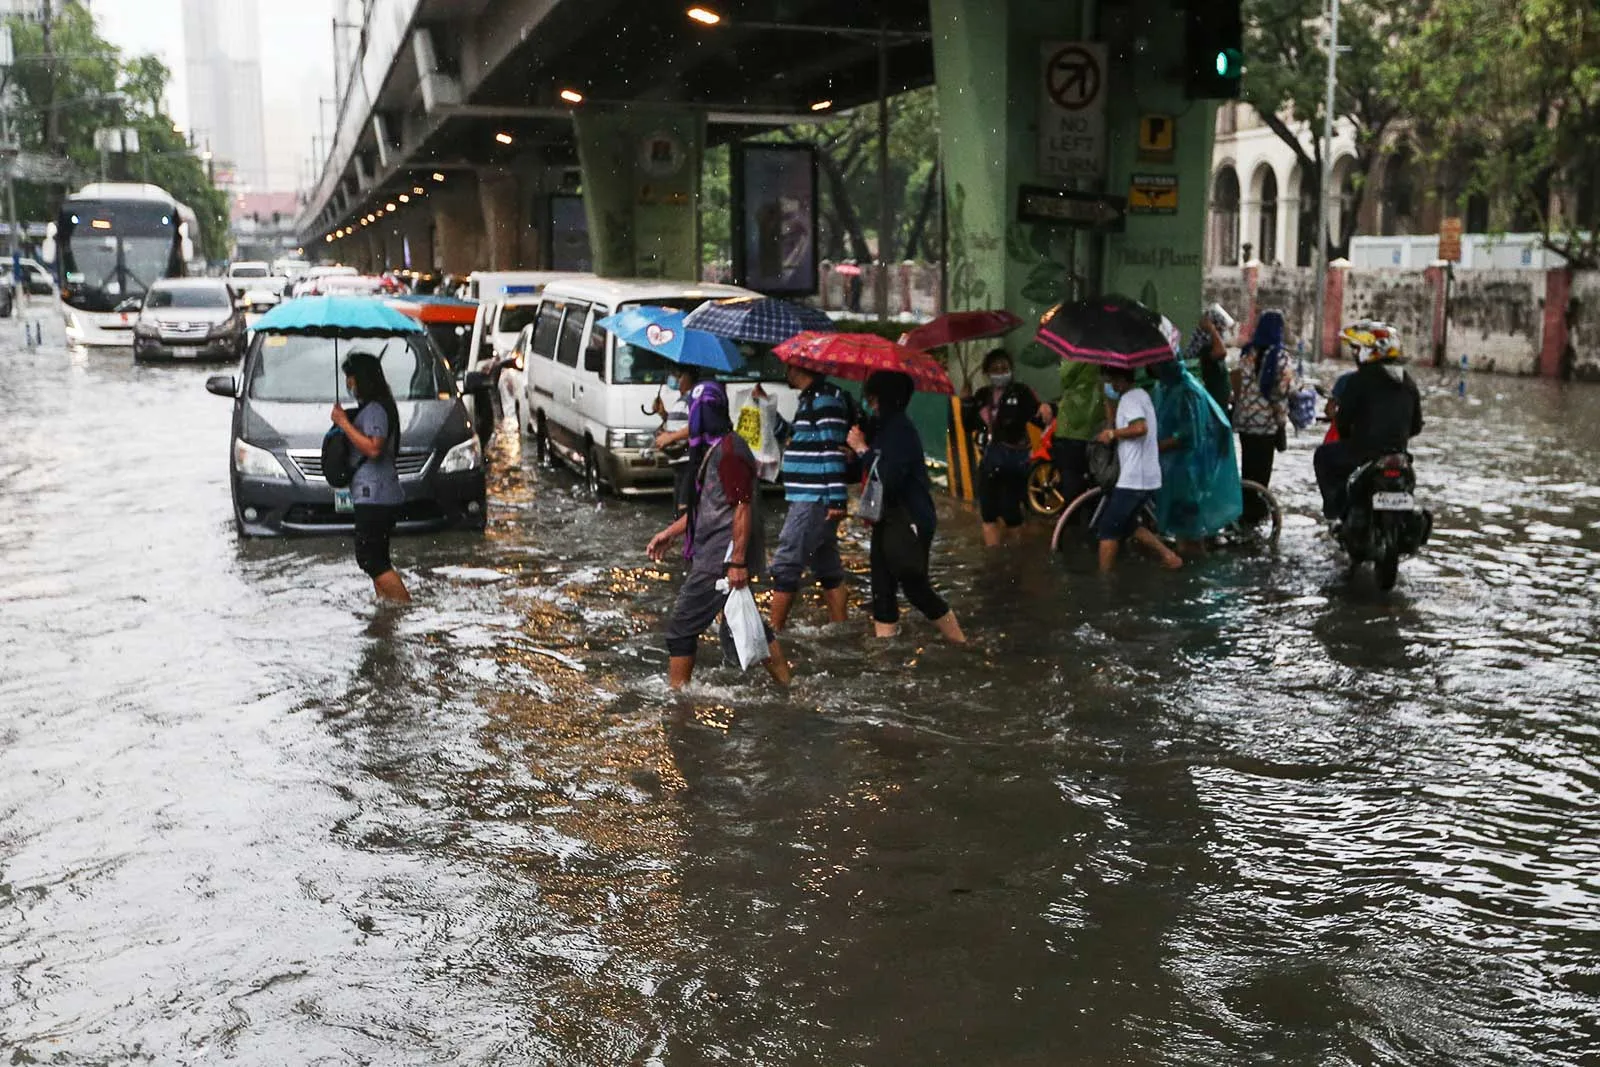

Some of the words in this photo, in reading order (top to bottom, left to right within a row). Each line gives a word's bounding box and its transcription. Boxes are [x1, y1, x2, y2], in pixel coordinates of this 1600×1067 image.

[1061, 116, 1088, 132] NO
[1050, 136, 1093, 152] LEFT
[1047, 156, 1098, 172] TURN
